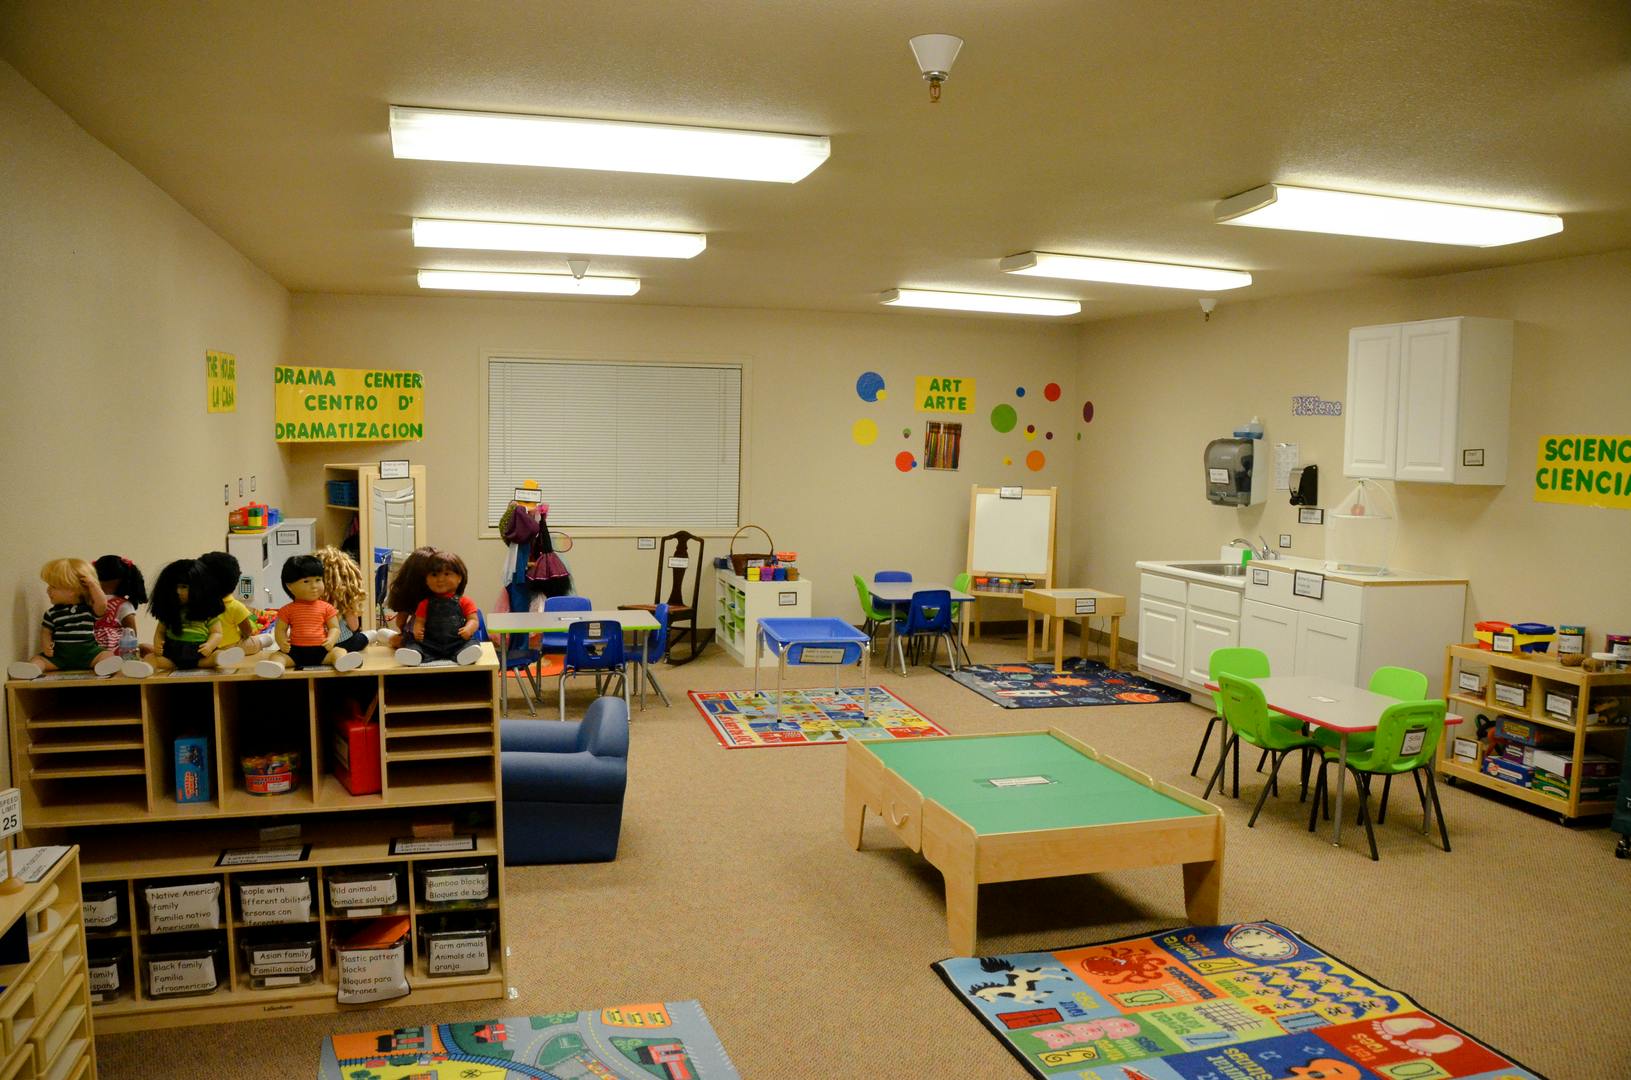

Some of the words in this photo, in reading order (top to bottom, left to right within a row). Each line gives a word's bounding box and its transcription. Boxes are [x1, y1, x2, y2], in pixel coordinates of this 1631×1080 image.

[207, 355, 218, 378] THE
[275, 367, 336, 386] DRAMA
[364, 372, 422, 388] CENTER
[930, 378, 962, 392] ART
[304, 394, 378, 411] CENTRO
[398, 395, 414, 411] D'
[924, 395, 967, 410] ARTE
[275, 422, 423, 439] DRAMATIZACION
[1545, 438, 1631, 463] SCIENC
[2, 814, 17, 831] 25
[348, 885, 377, 894] animals
[429, 890, 458, 899] Bloques
[151, 890, 180, 900] Native
[153, 902, 179, 912] family
[154, 913, 184, 922] Familia
[243, 909, 276, 917] ersonas
[434, 942, 454, 950] Farm
[456, 940, 484, 949] animals
[260, 952, 282, 960] Asian
[284, 950, 309, 960] family
[341, 955, 368, 963] Plastic
[369, 953, 398, 964] pattern
[466, 951, 475, 959] de
[153, 962, 175, 972] Black
[177, 960, 203, 970] family
[253, 965, 281, 974] Familia
[342, 966, 367, 974] blocks
[434, 963, 460, 971] granja
[154, 974, 184, 983] Familia
[342, 976, 372, 986] Bloques
[374, 975, 392, 985] para
